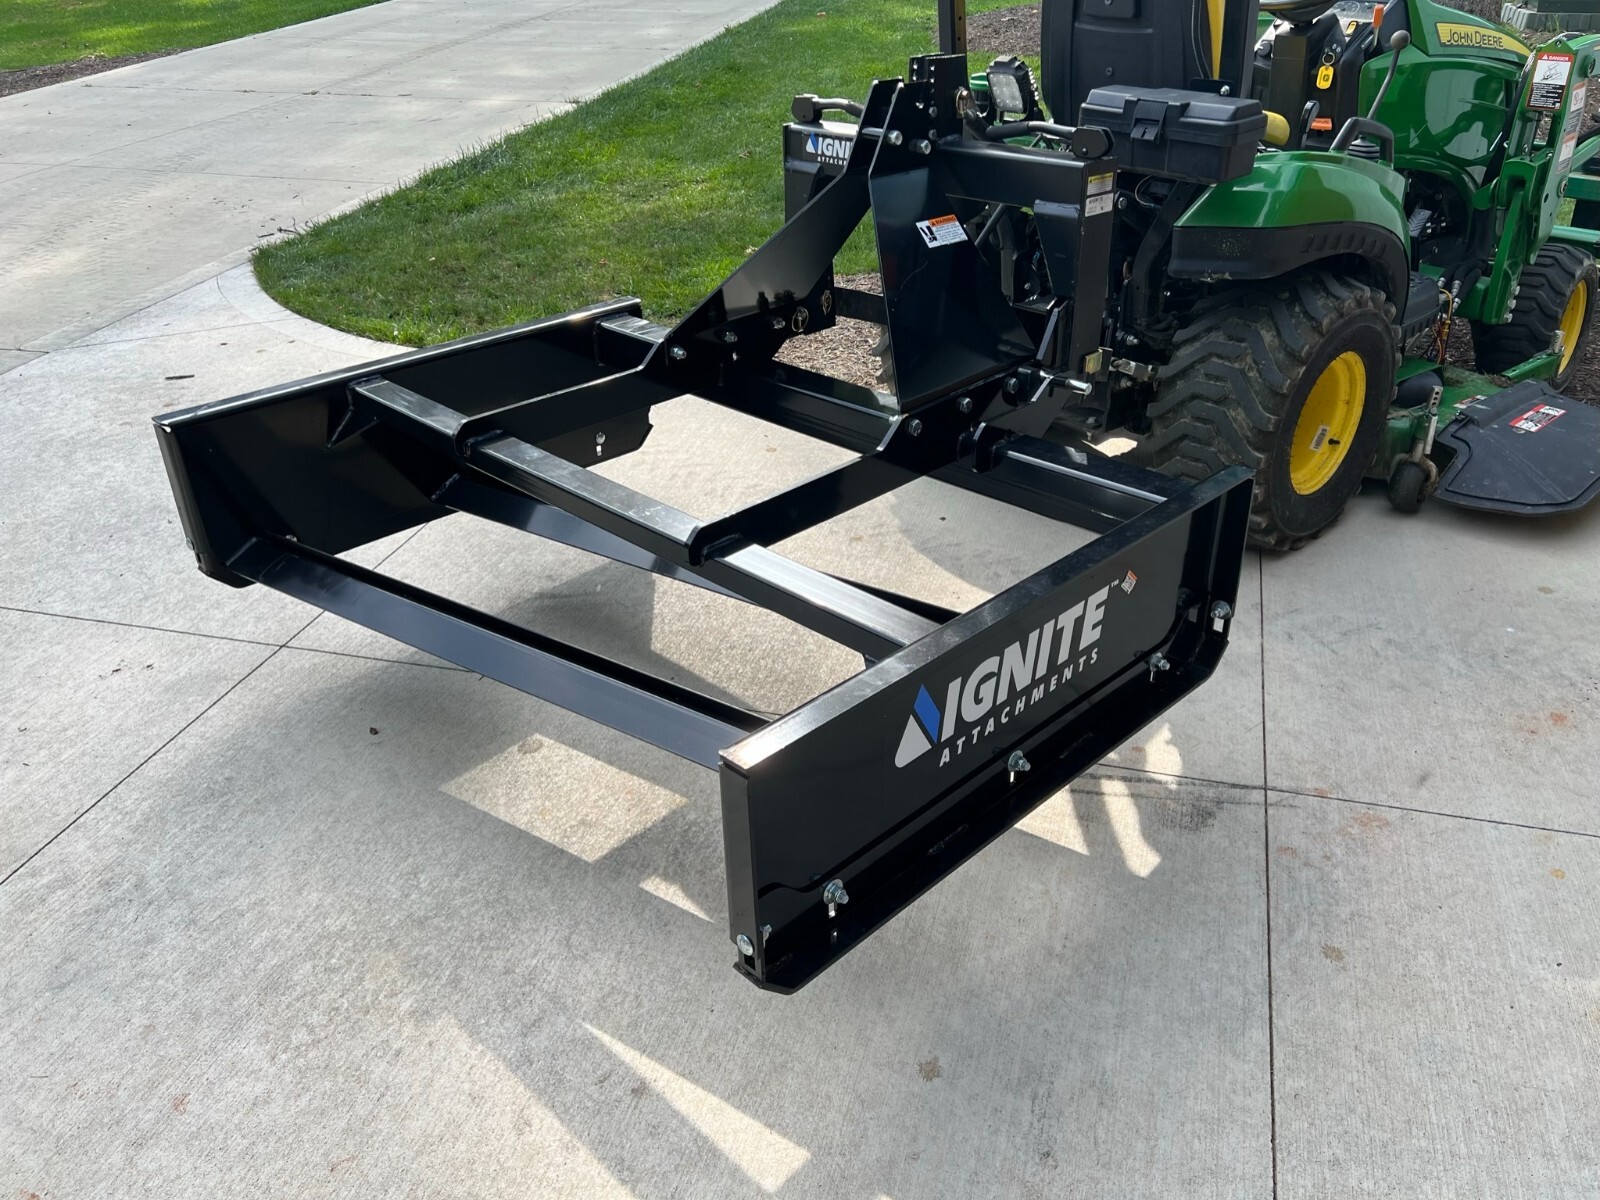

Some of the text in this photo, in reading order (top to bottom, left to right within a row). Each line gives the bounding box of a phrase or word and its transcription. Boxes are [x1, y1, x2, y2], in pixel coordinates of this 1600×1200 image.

[1446, 29, 1504, 48] JOHN DEERE
[817, 137, 853, 159] IGNI
[940, 584, 1110, 742] IGNITE
[939, 648, 1098, 767] ATTACHMENTS
